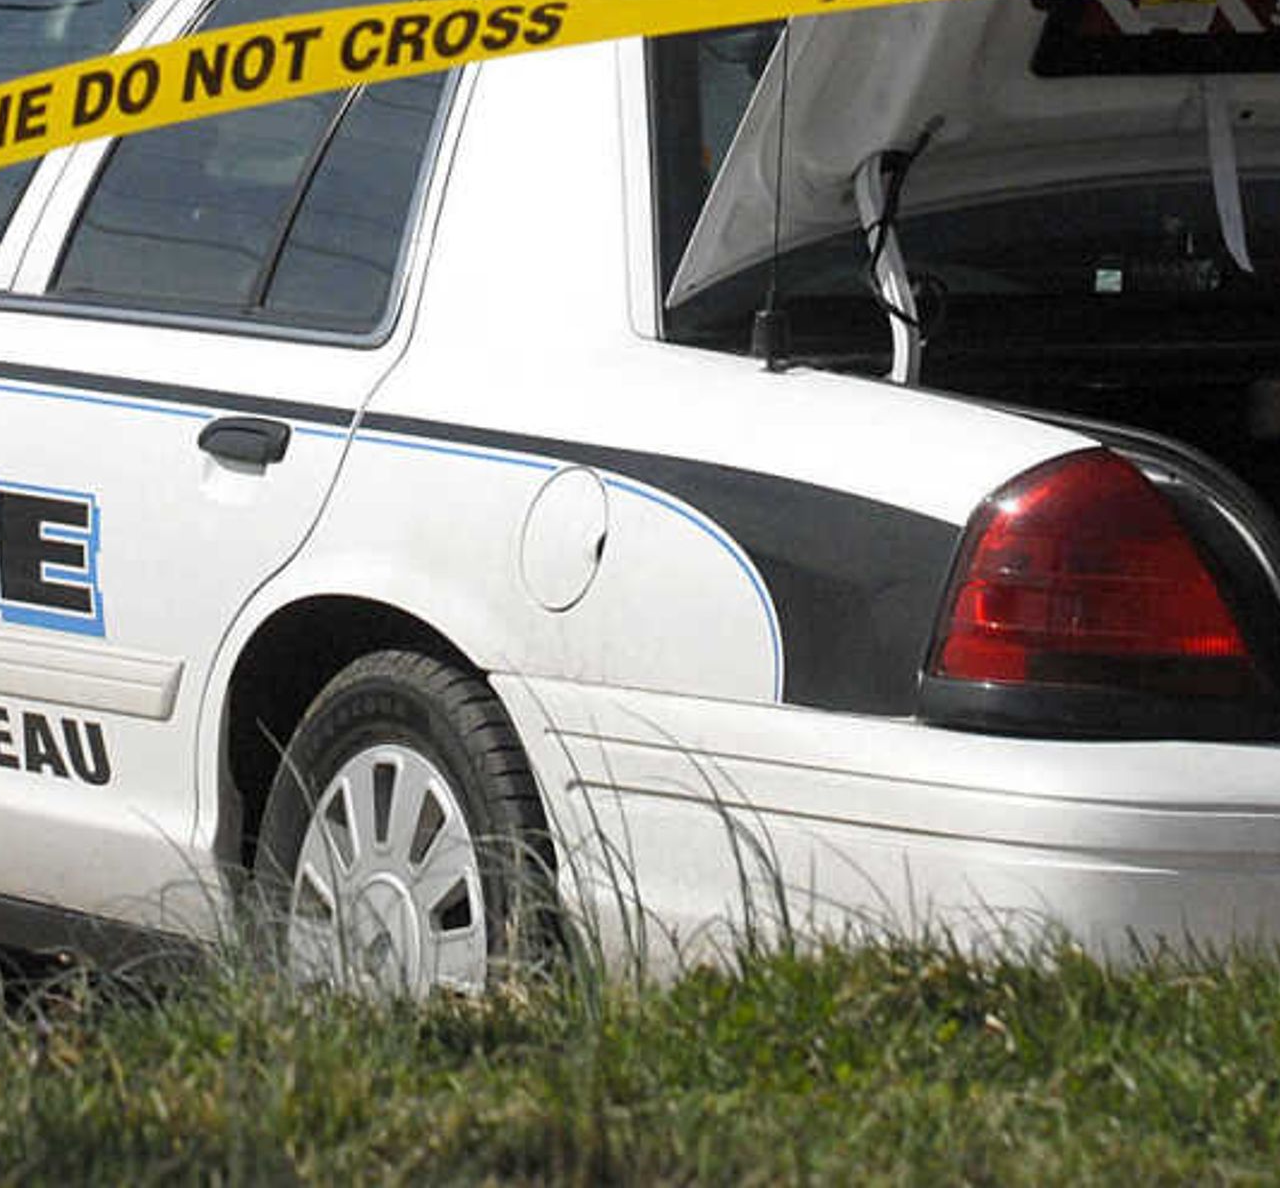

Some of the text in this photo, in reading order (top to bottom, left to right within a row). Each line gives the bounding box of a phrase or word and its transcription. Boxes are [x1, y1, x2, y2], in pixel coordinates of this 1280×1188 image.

[72, 59, 160, 128] DO
[183, 28, 323, 101] NOT
[340, 2, 568, 72] CROSS
